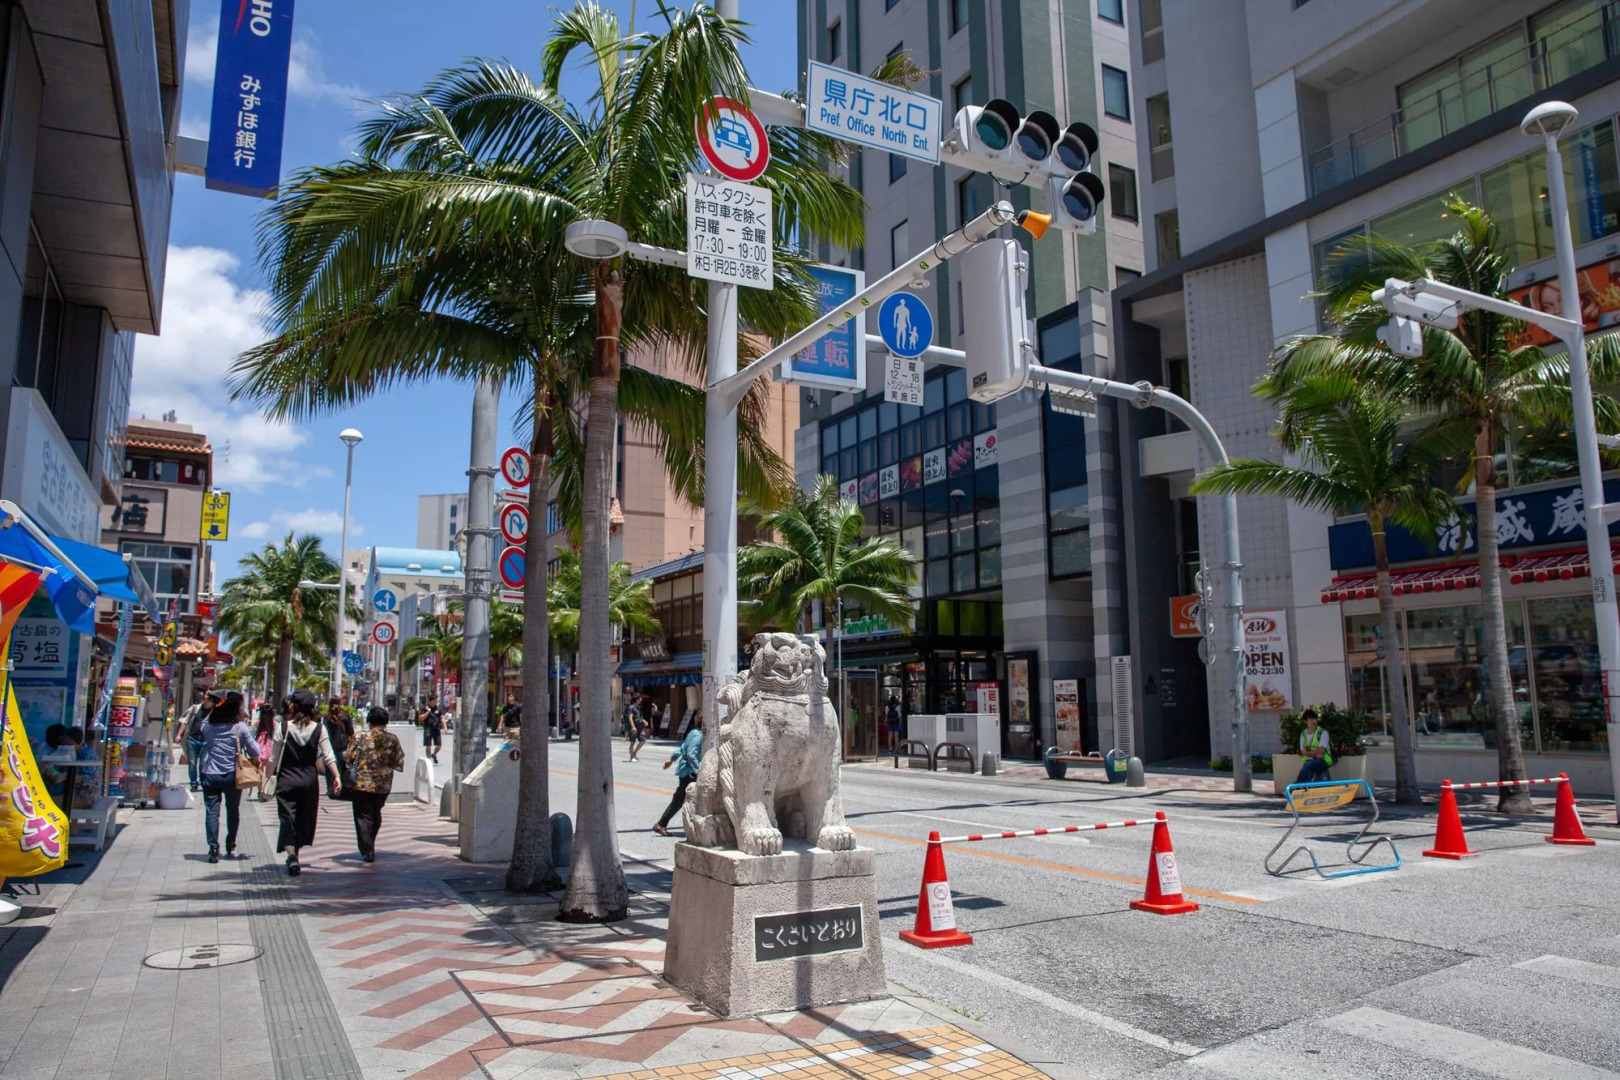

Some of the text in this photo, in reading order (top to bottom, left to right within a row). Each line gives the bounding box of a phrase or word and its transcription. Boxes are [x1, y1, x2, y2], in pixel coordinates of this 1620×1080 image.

[823, 78, 927, 131] 県庁北口
[233, 74, 262, 168] みずほ銀行
[820, 107, 931, 152] Pref. Office North Ent.
[694, 181, 766, 207] バス・タクシー
[694, 198, 767, 227] 許可車を除く
[890, 390, 918, 403] 実施日
[377, 628, 391, 639] 30
[347, 658, 361, 668] 39
[761, 918, 857, 949] こくさいとおり
